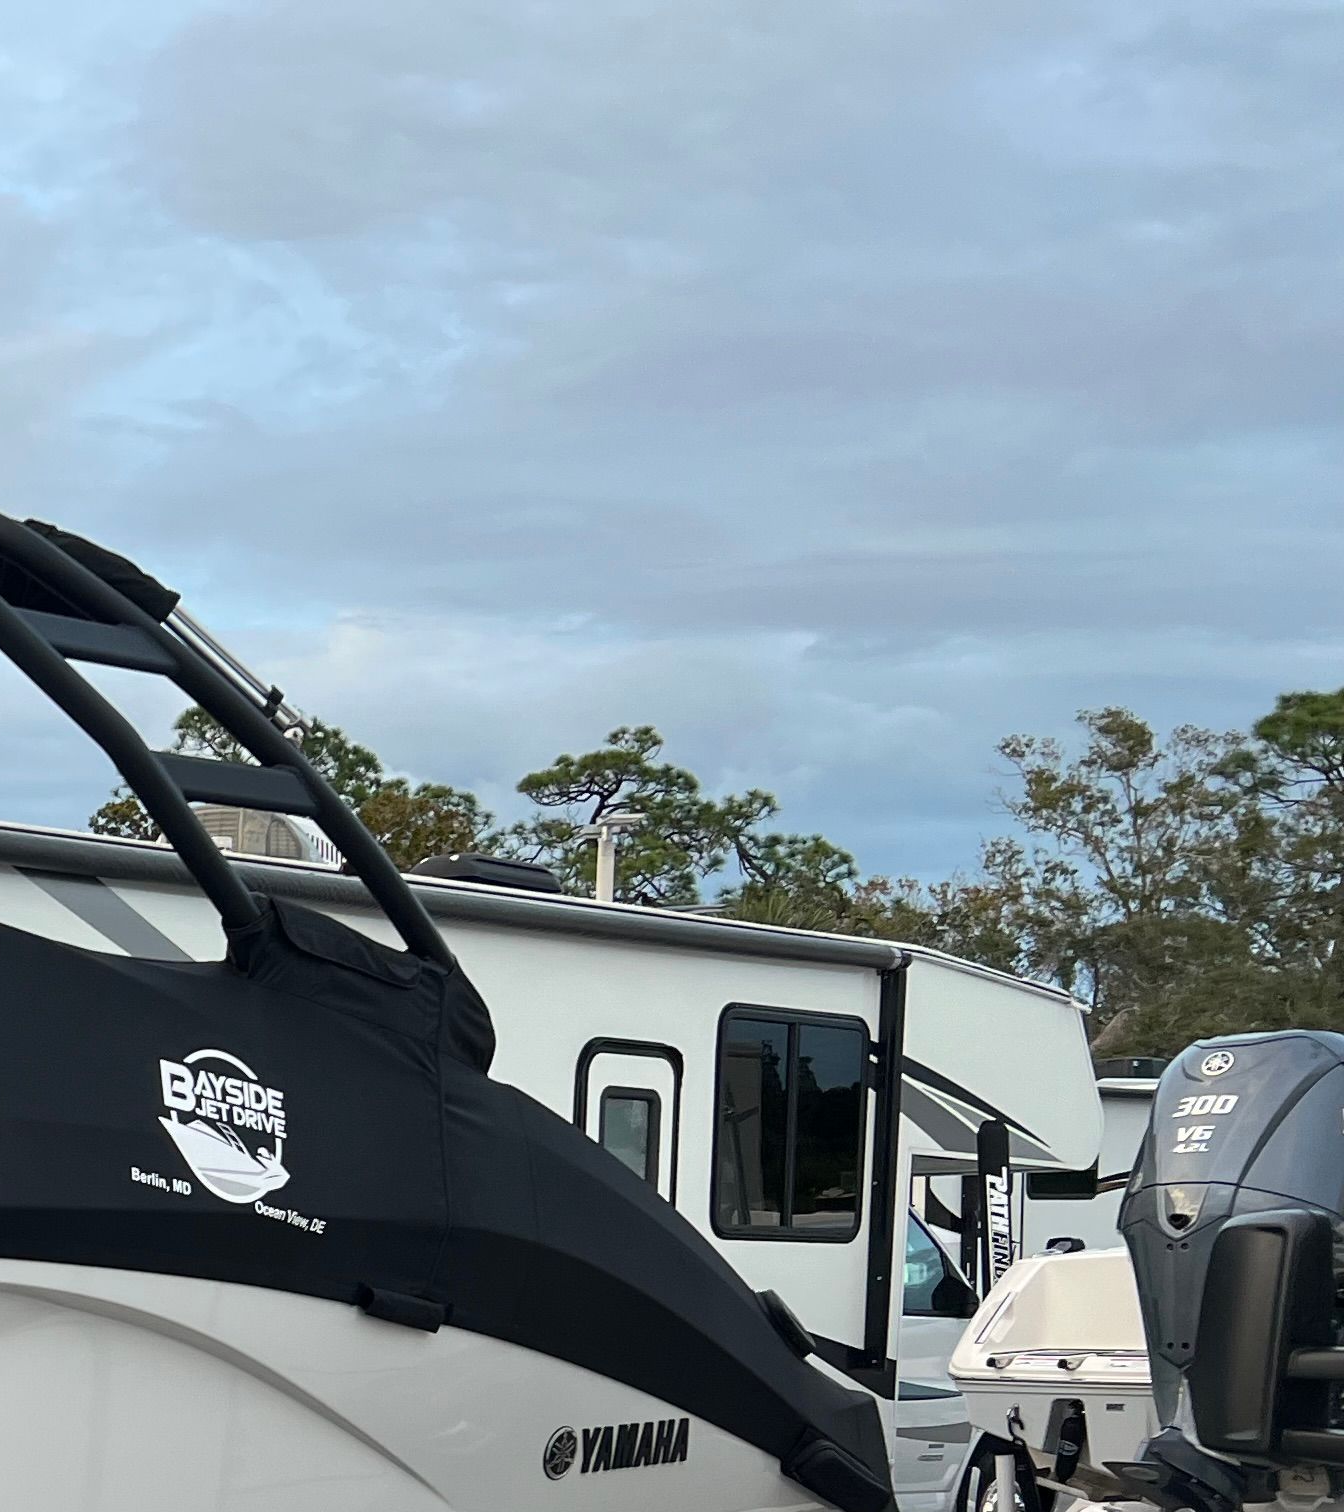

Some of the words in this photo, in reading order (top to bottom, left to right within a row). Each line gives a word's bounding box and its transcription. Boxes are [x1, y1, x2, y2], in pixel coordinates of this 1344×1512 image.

[159, 1059, 286, 1118] BAYSIDE
[1171, 1094, 1240, 1118] 300
[195, 1098, 230, 1123] JET
[232, 1105, 288, 1139] DRIVE
[1177, 1125, 1216, 1142] V6
[130, 1166, 170, 1193] Berlin,
[172, 1178, 192, 1196] MD
[254, 1200, 286, 1221] Ocean
[309, 1217, 327, 1235] DE
[985, 1165, 1012, 1286] PATHFIND
[580, 1418, 690, 1474] YAMAHA
